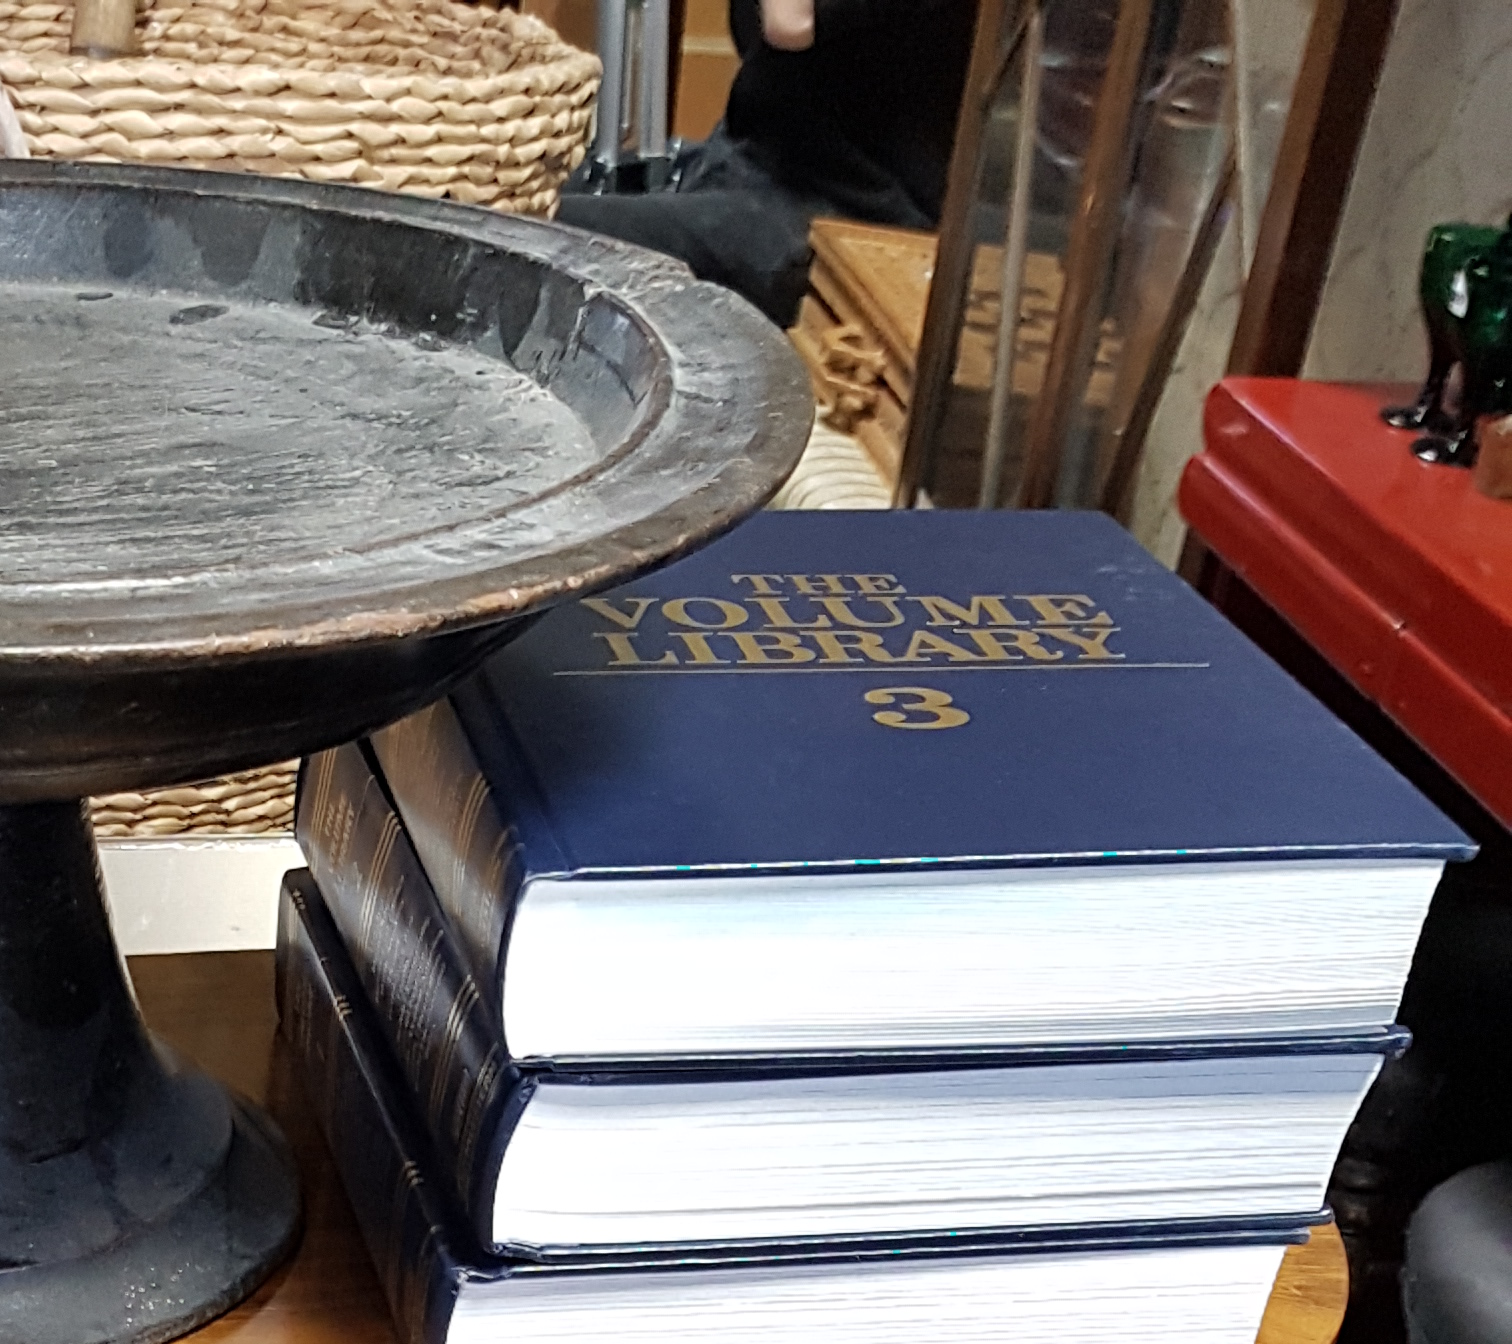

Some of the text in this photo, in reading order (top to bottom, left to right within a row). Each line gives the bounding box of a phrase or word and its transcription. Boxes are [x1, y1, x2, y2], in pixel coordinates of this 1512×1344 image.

[730, 572, 907, 595] THE
[579, 594, 1115, 630] VOLUME
[592, 627, 1126, 667] LIBRARY
[863, 685, 971, 731] 3
